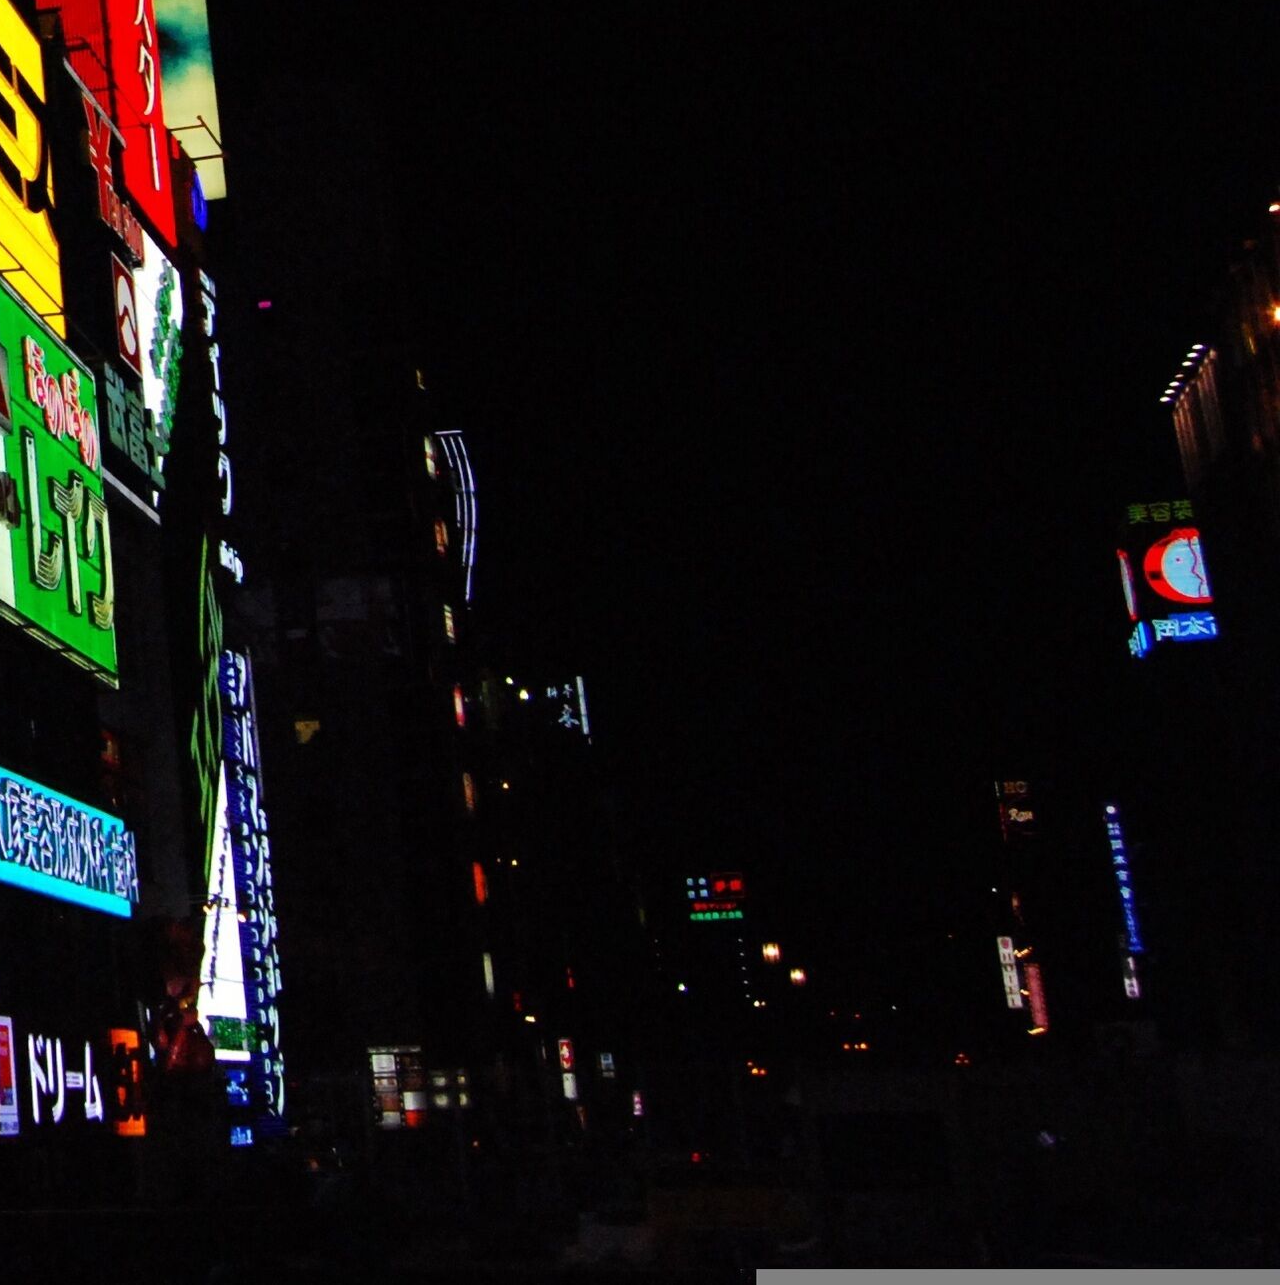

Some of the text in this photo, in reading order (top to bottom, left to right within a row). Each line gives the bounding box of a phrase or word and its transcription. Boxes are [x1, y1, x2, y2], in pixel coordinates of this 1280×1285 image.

[22, 426, 115, 632] レイク
[27, 1032, 104, 1125] ドリーム
